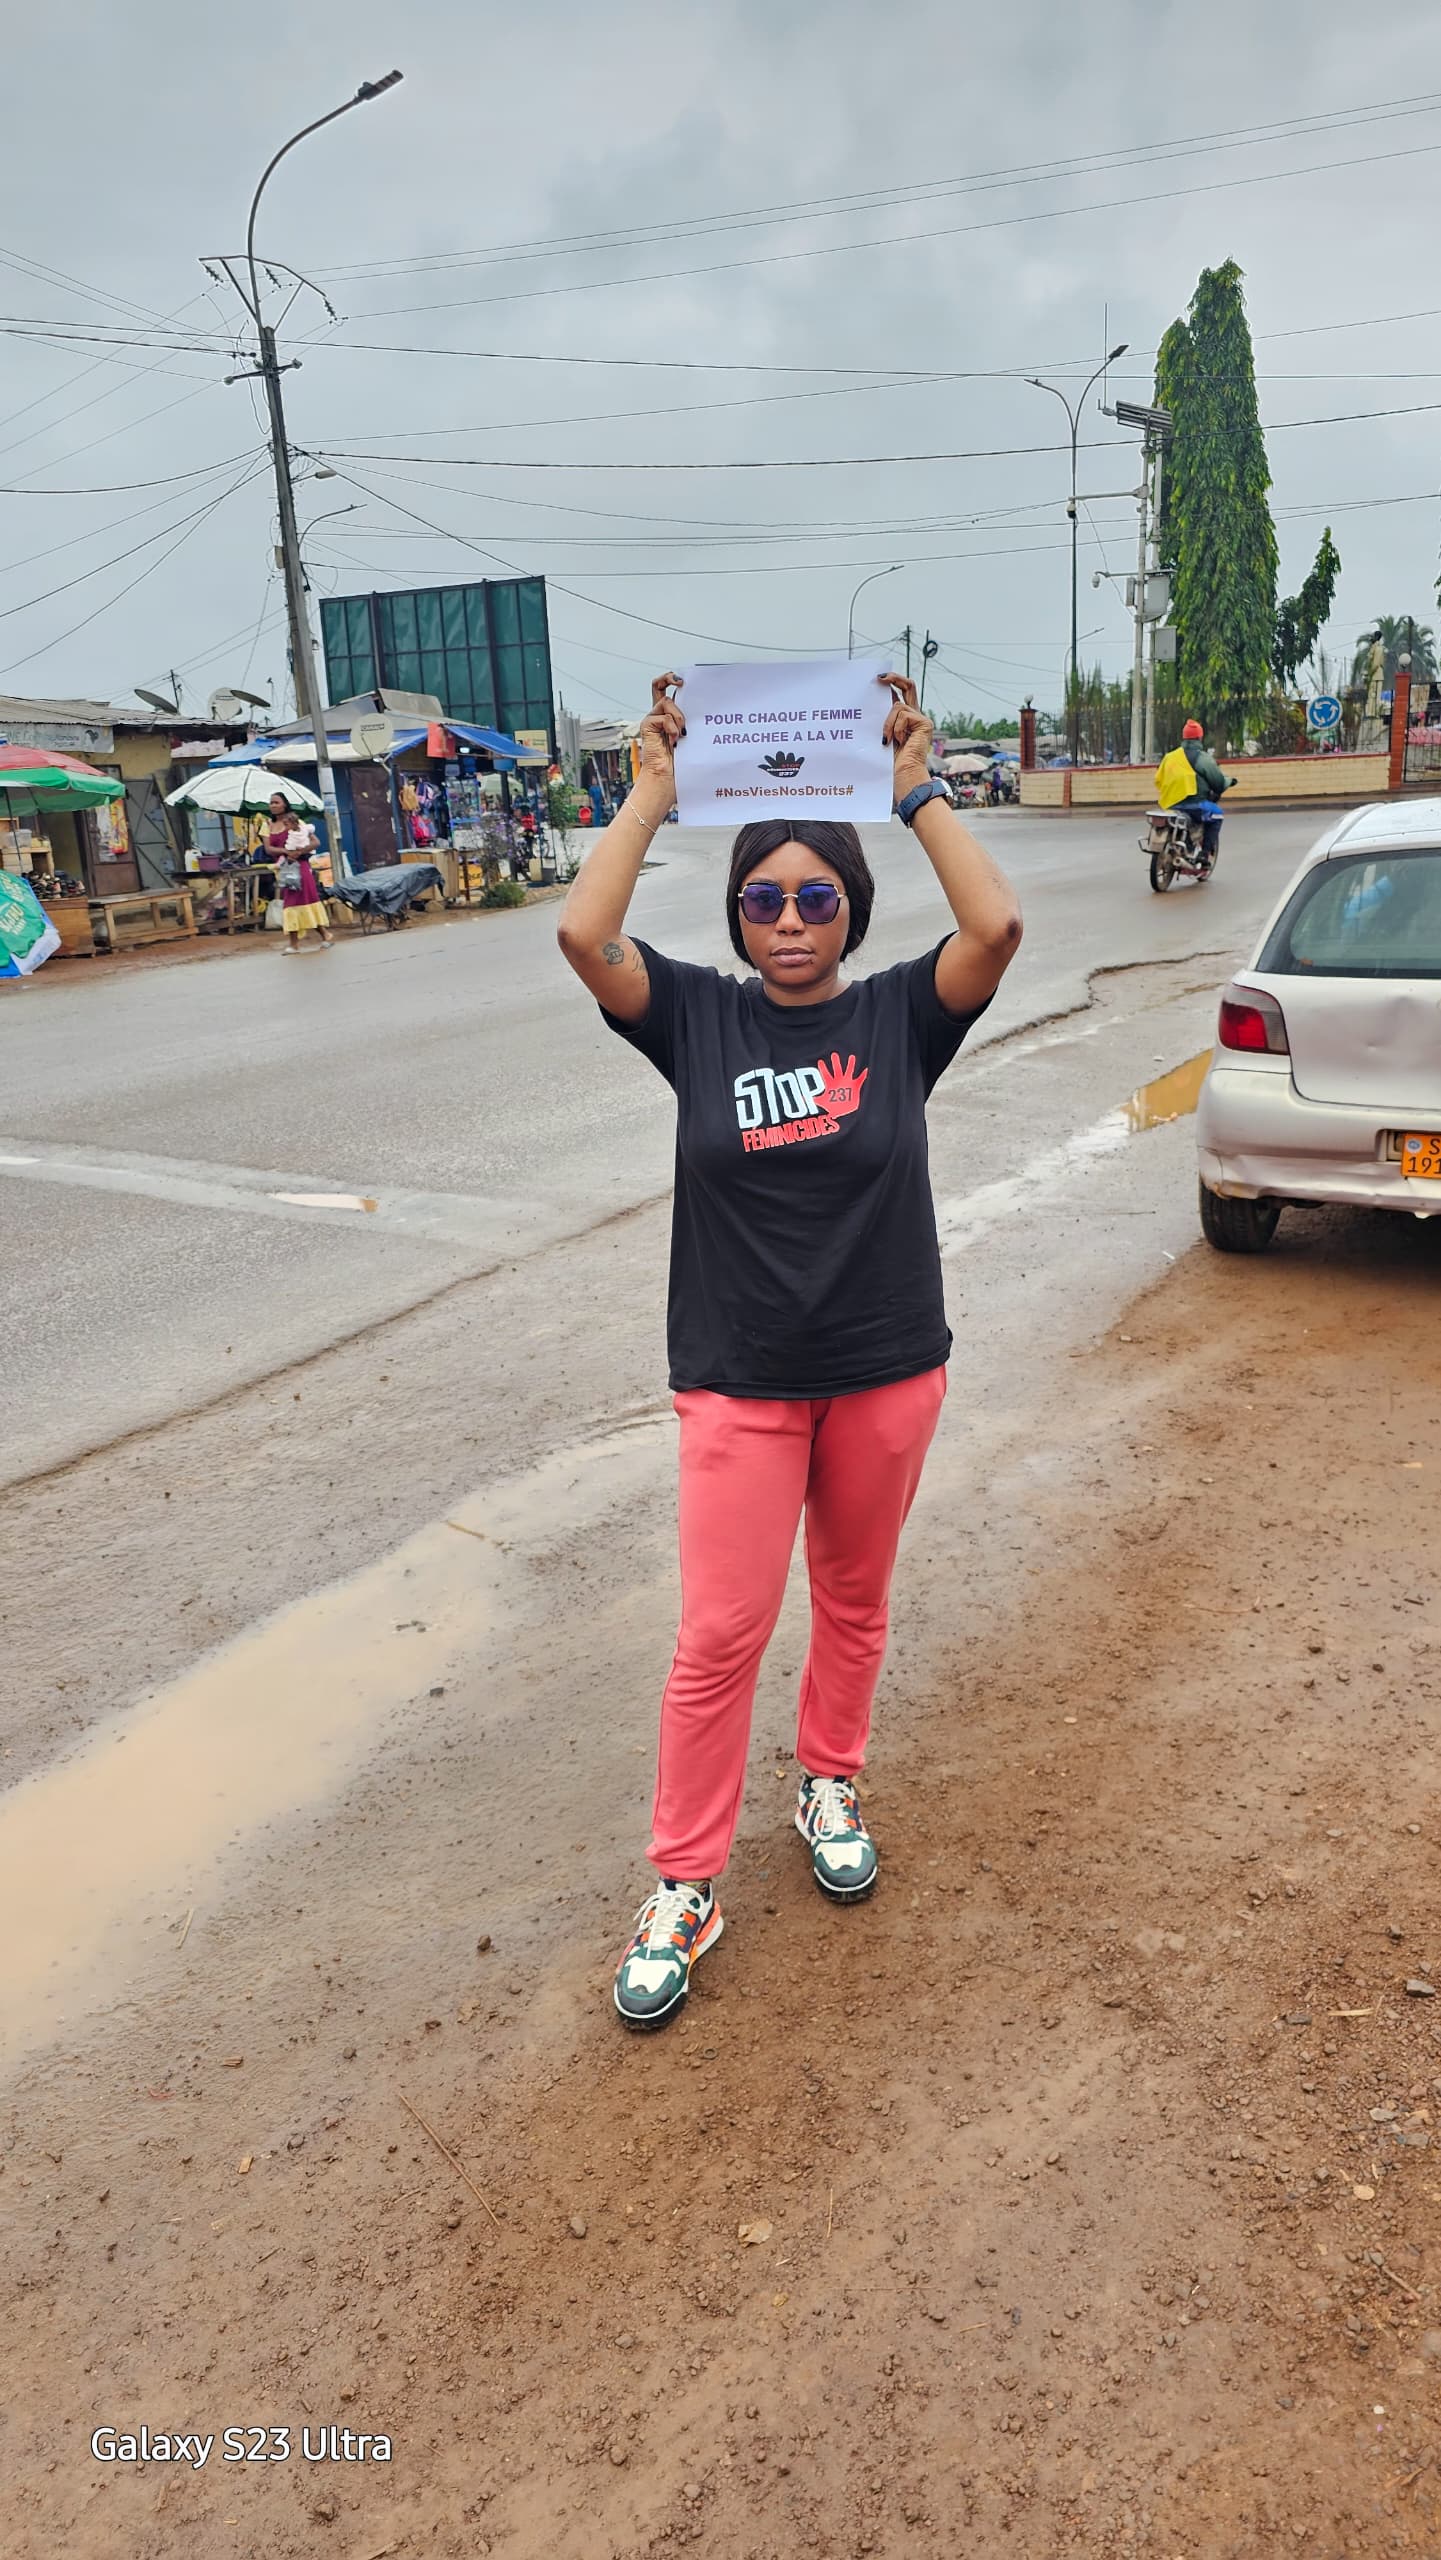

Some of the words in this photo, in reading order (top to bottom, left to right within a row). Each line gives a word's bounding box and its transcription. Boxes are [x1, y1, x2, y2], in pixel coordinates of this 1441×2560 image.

[704, 713, 744, 725] POUR
[748, 710, 807, 724] CHAQUE
[812, 708, 862, 721] FEMME
[712, 731, 789, 745] ARRACHEE
[793, 731, 802, 742] A
[807, 730, 826, 742] LA
[830, 729, 854, 740] VIE
[715, 785, 854, 798] #NosViesNosDroits#
[734, 1067, 826, 1129] STOP
[828, 1087, 852, 1102] 237
